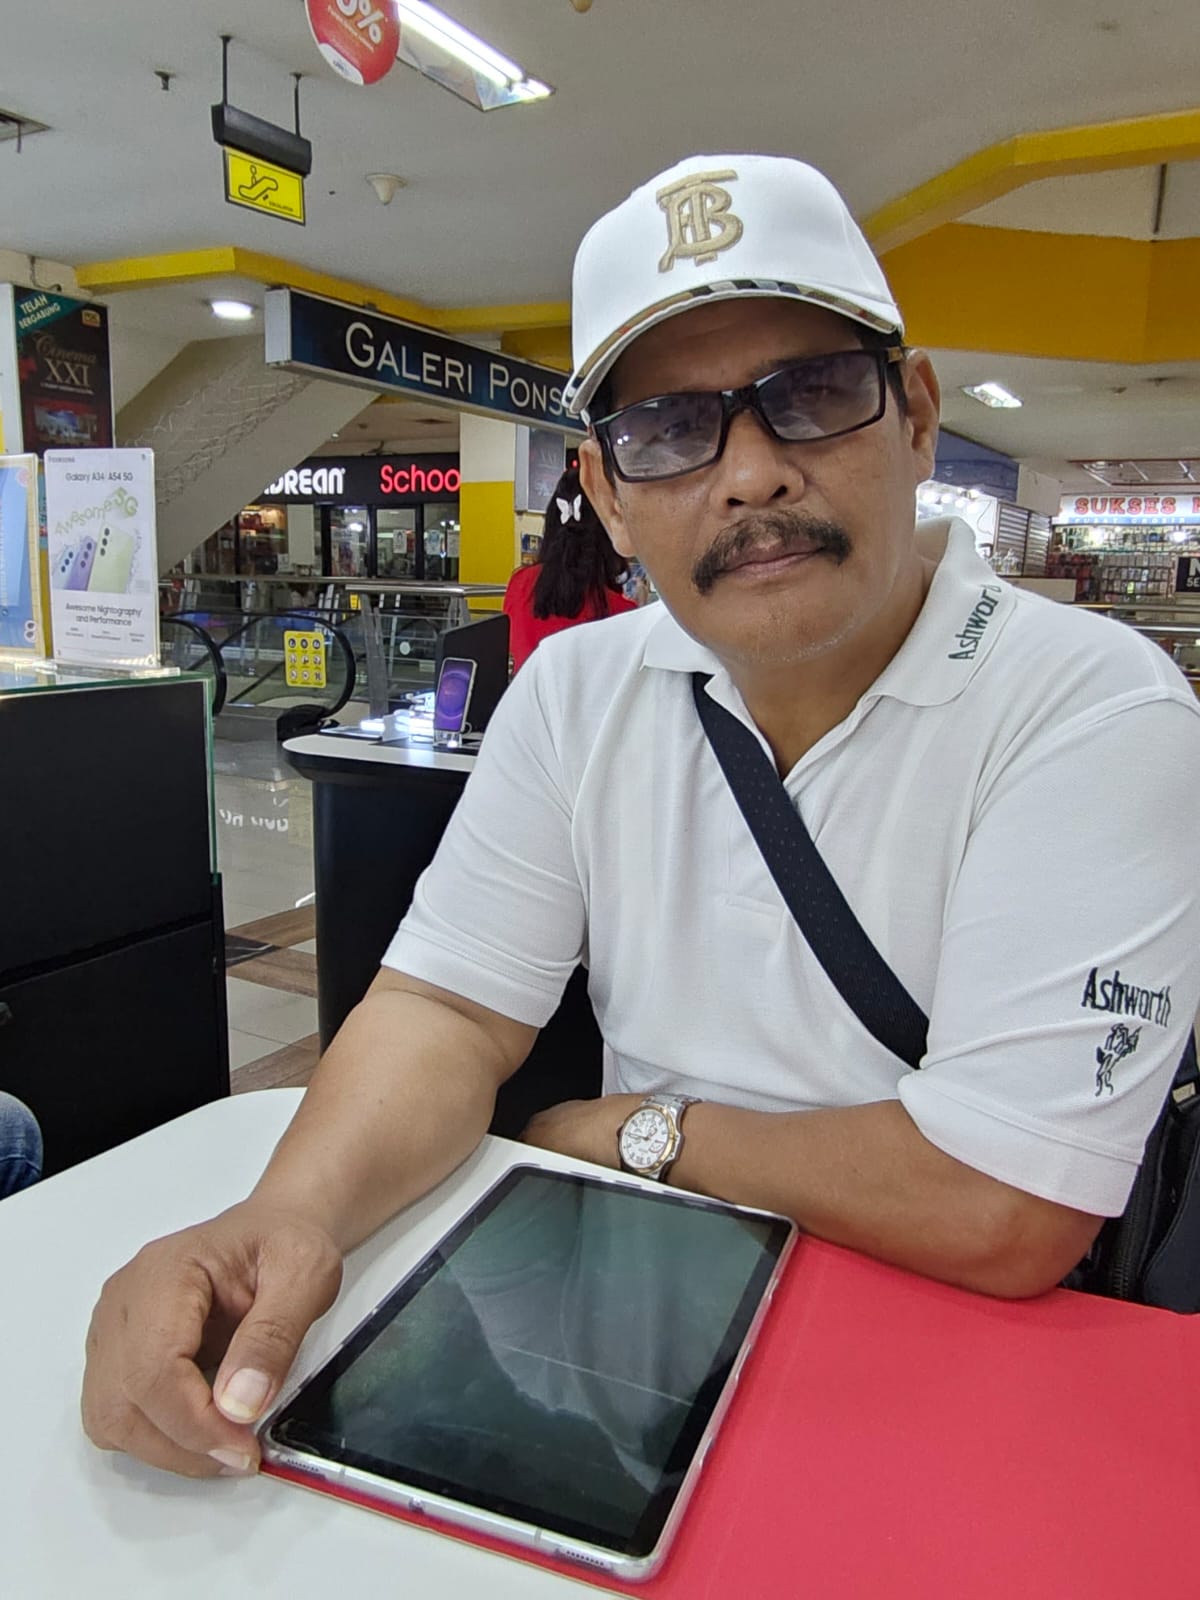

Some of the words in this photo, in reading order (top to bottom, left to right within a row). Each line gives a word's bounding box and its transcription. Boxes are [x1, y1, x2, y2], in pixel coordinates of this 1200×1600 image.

[20, 294, 48, 314] TELAH
[345, 321, 472, 394] GALERI
[44, 358, 90, 388] XXI
[65, 472, 90, 483] Galaxy
[92, 472, 105, 481] A34
[108, 472, 121, 481] A54
[123, 472, 134, 481] 5G
[112, 486, 139, 518] 5G
[1074, 497, 1176, 514] SUKSES
[65, 602, 96, 612] Awesome
[97, 604, 143, 618] Nightography
[89, 615, 132, 627] Performance
[1081, 967, 1171, 1028] Ashworth
